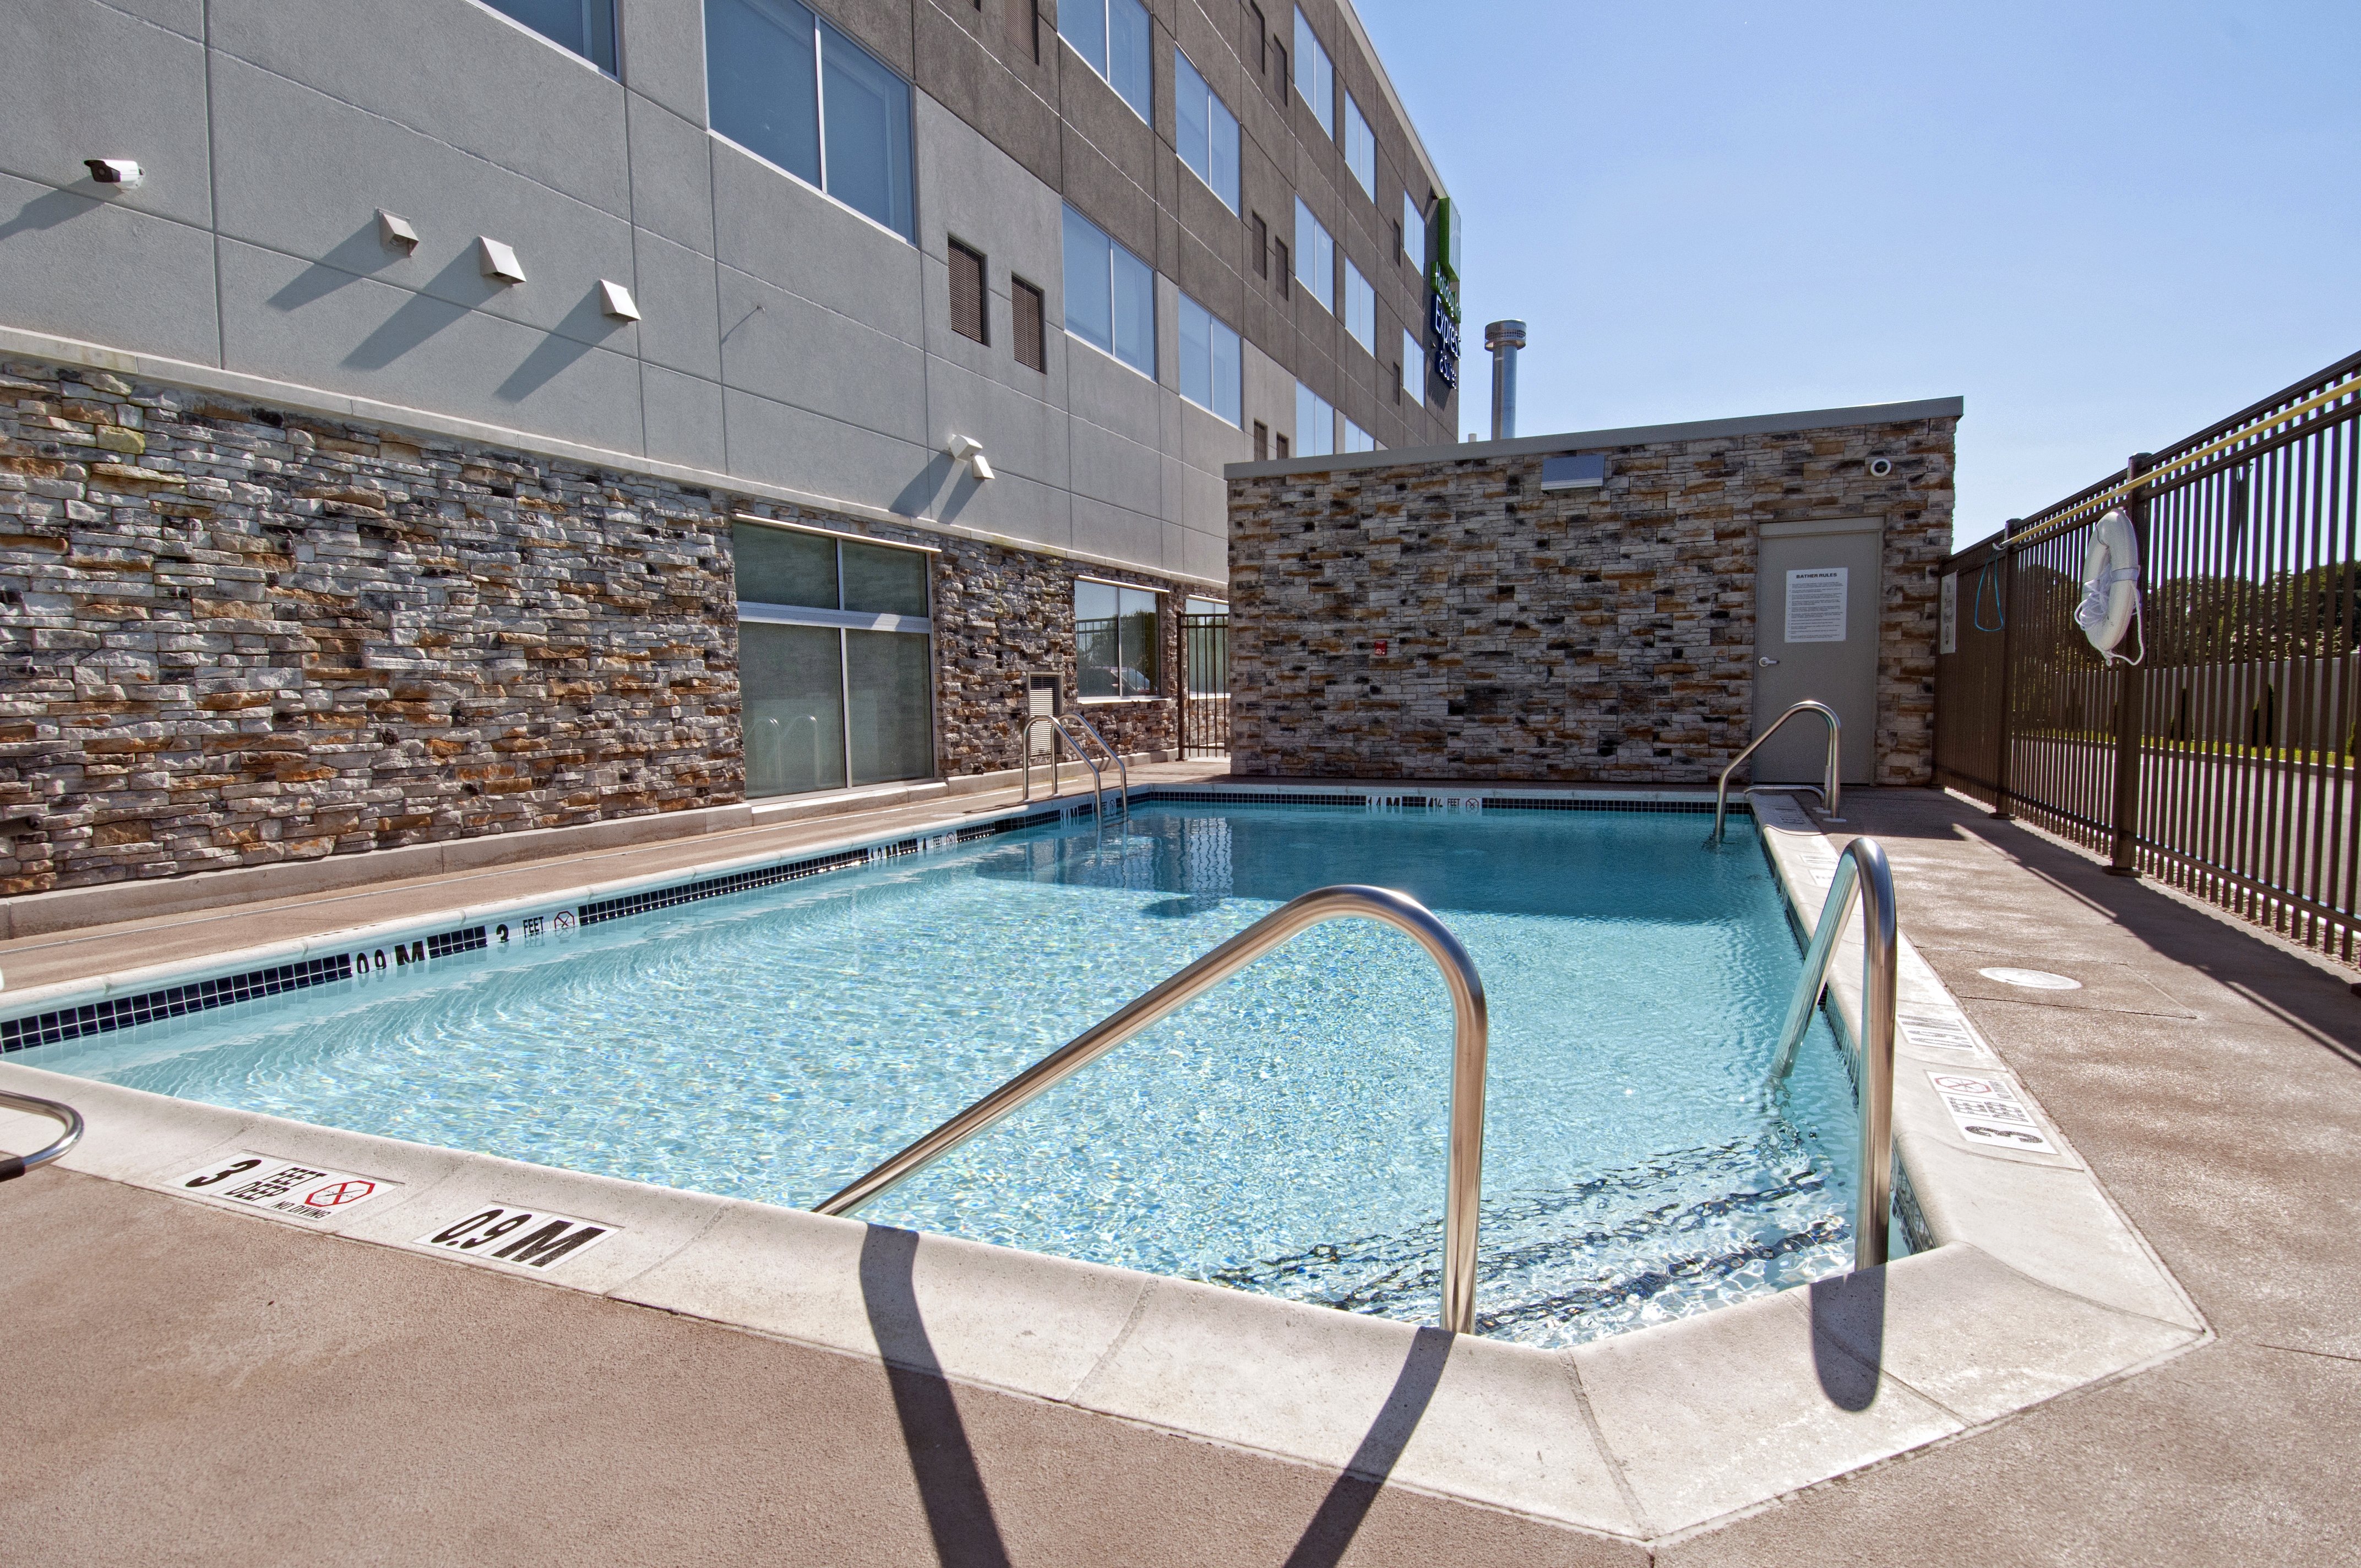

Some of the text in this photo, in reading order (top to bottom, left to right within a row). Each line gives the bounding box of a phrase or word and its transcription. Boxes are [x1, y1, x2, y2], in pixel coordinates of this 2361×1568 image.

[1435, 262, 1454, 318] Holiday
[1435, 293, 1461, 361] Express
[1447, 798, 1460, 807] FEET
[933, 835, 942, 846] FEET
[523, 916, 544, 935] FEET
[394, 940, 425, 966] M
[1965, 1126, 2043, 1144] 3
[186, 1159, 262, 1188] 3
[262, 1167, 328, 1188] FEET
[224, 1181, 291, 1202] DEEP
[270, 1201, 331, 1219] NO DIVING
[431, 1209, 607, 1267] 0.9 M
